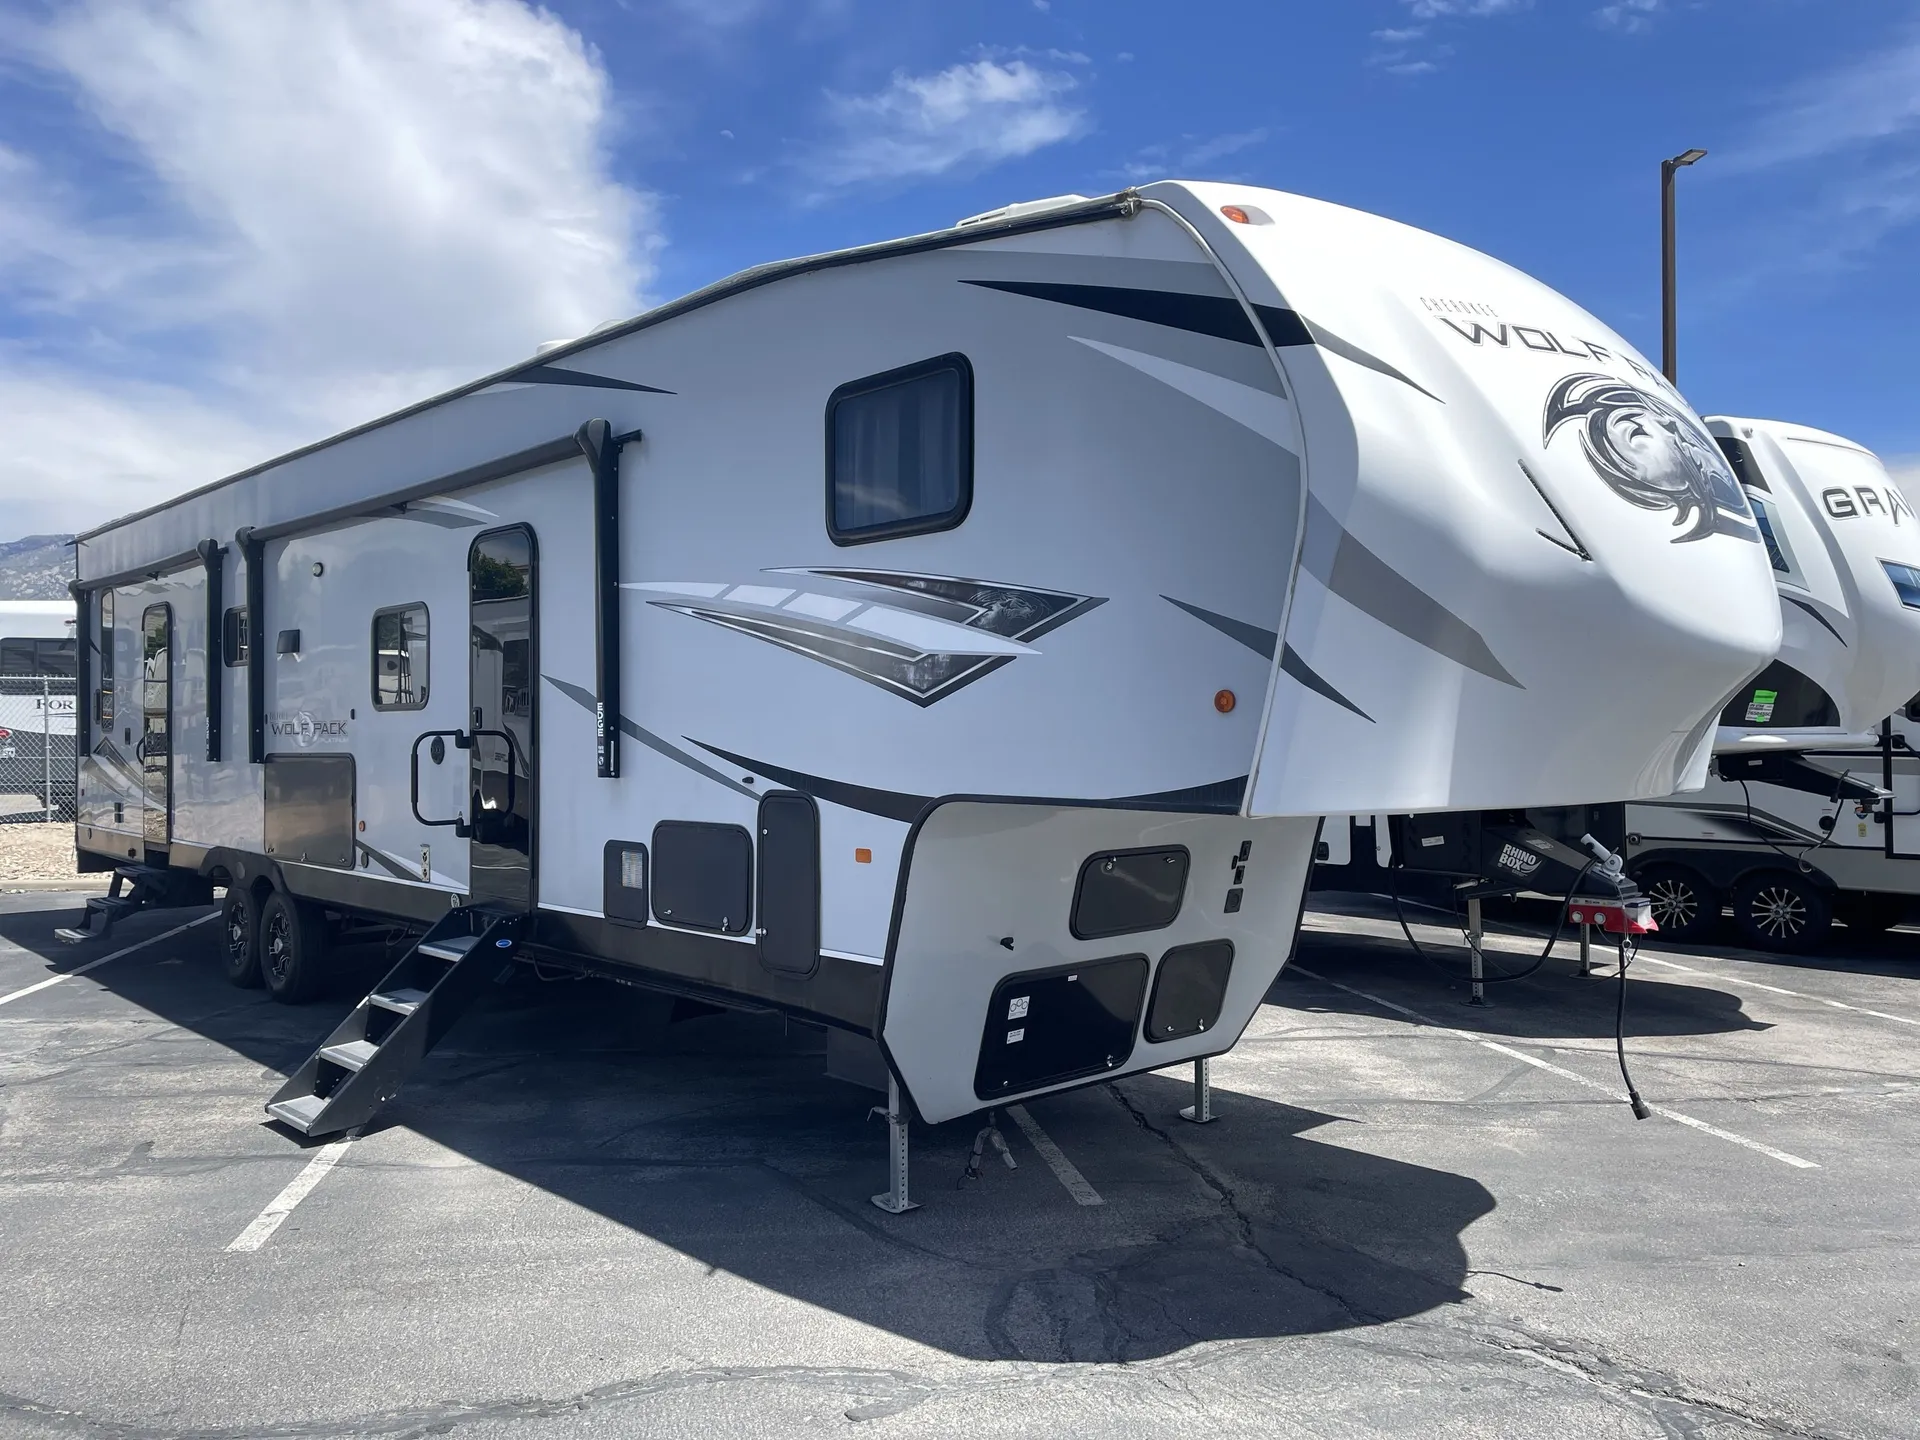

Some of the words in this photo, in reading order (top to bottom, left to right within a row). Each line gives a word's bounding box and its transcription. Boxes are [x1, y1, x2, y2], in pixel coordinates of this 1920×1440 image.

[1420, 297, 1498, 317] CHEROKEE
[1436, 315, 1613, 364] WOLF
[270, 722, 309, 735] WOLF
[312, 721, 348, 735] PACK
[1498, 853, 1524, 870] BOX
[1503, 843, 1537, 865] RHINO
